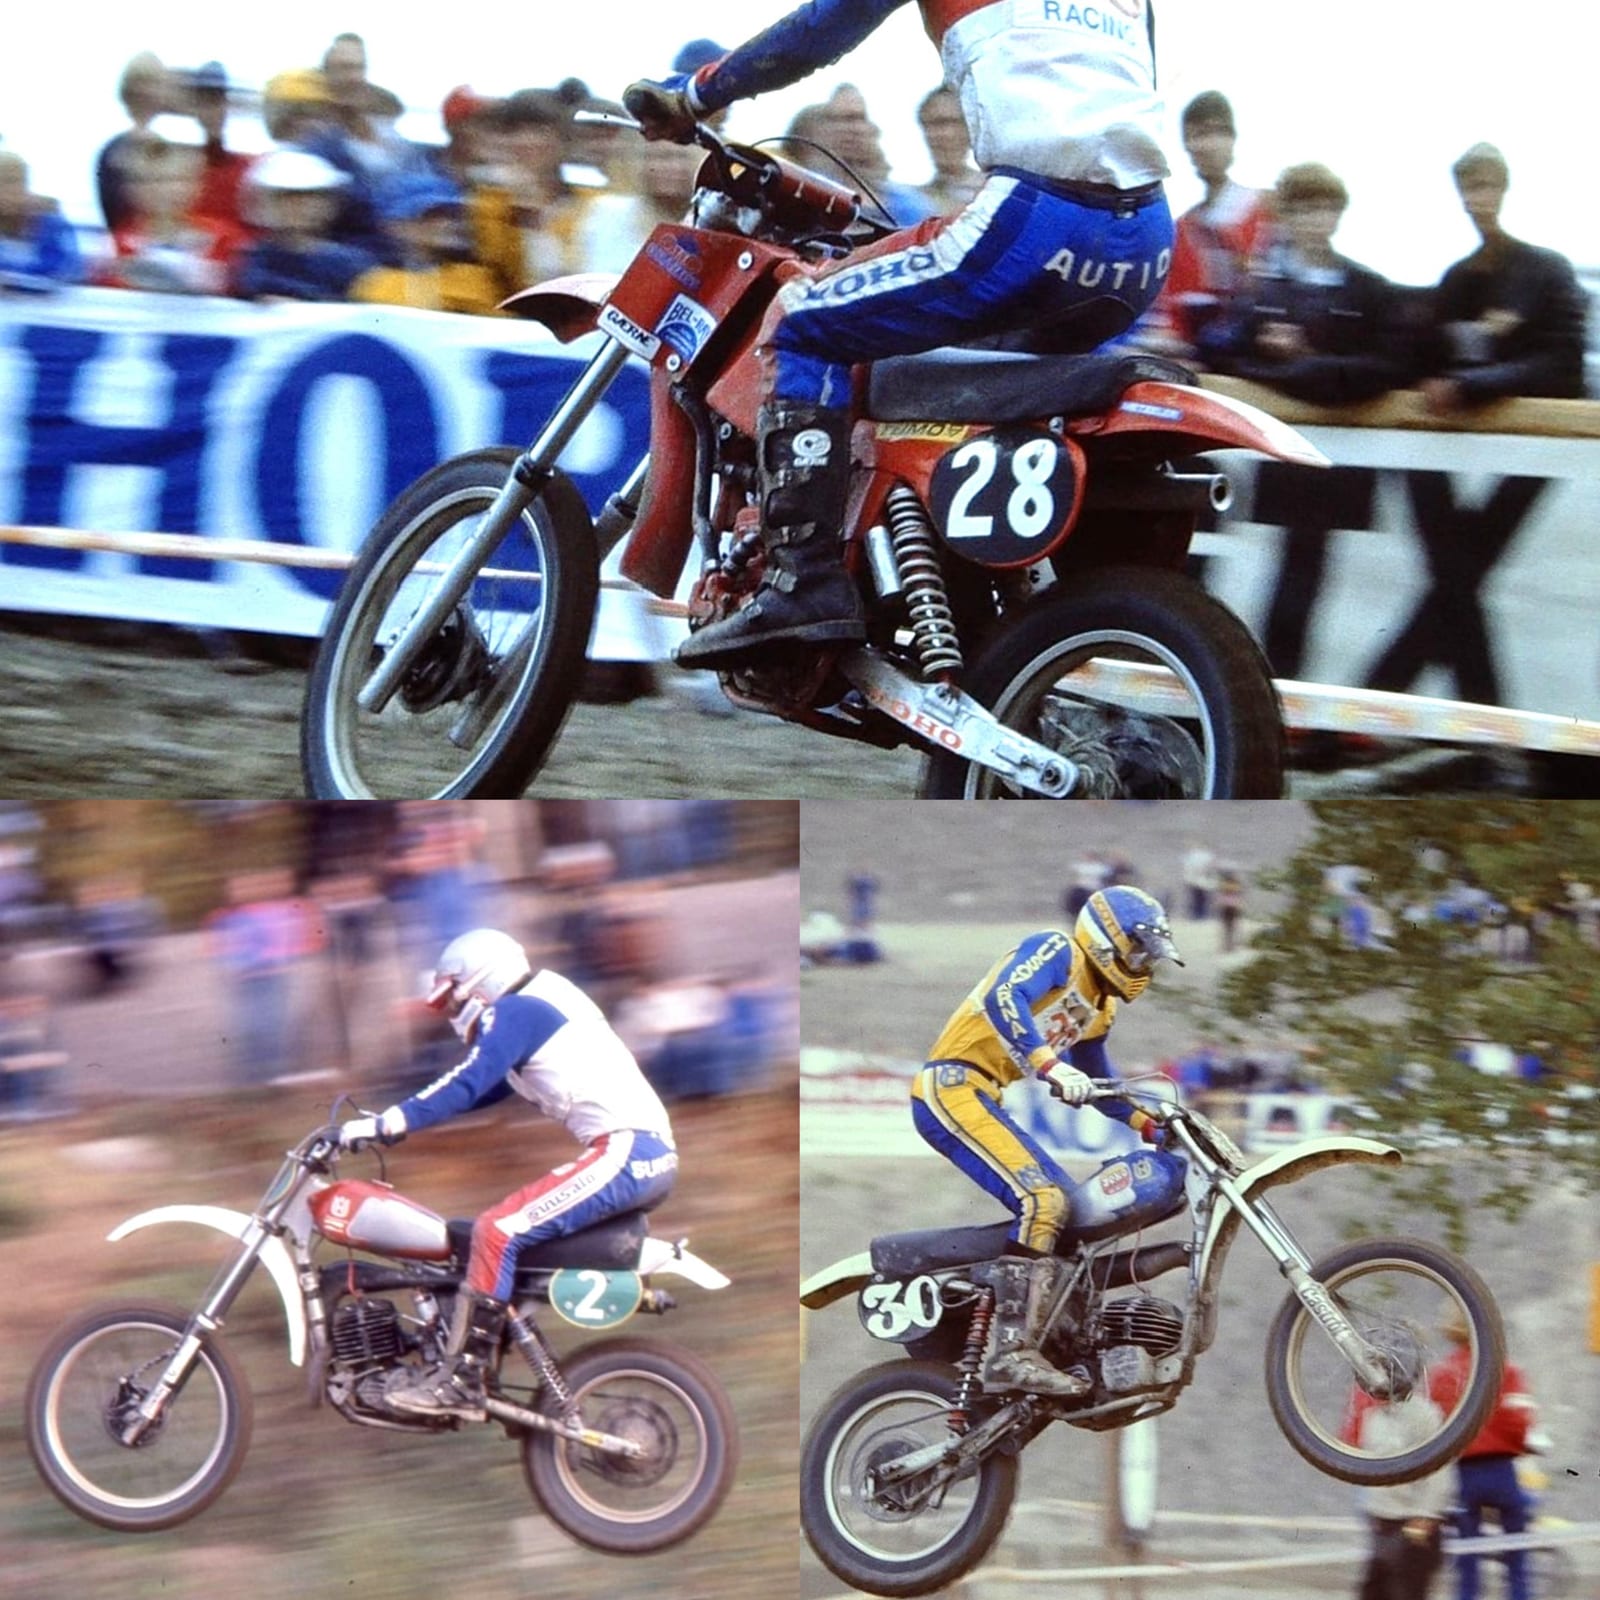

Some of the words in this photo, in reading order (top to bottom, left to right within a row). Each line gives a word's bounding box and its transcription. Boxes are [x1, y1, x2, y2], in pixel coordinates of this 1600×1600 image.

[1043, 0, 1136, 47] RACIN
[946, 437, 1058, 538] 28
[574, 1269, 607, 1320] 2
[862, 1275, 944, 1338] 30
